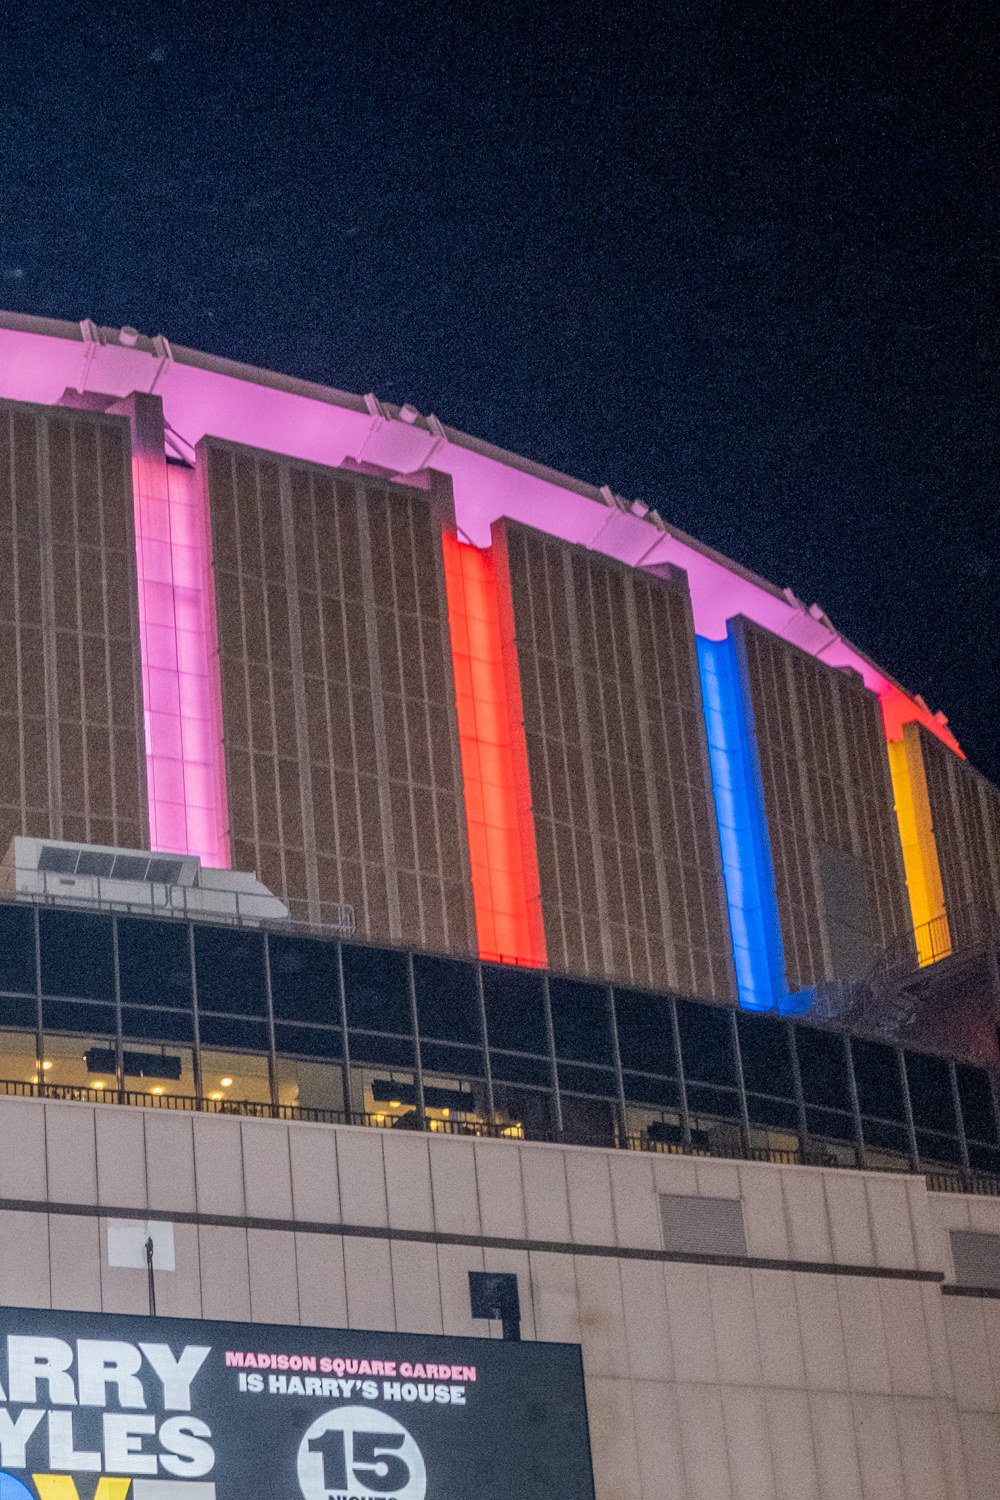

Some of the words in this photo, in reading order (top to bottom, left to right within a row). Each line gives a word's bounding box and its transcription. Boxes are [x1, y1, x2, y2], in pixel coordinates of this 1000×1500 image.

[225, 1351, 317, 1372] MADISON
[319, 1357, 397, 1378] SQUARE
[399, 1362, 477, 1381] GARDEN
[239, 1373, 264, 1393] IS
[269, 1375, 379, 1399] HARRY'S
[383, 1381, 466, 1405] HOUSE
[307, 1428, 411, 1492] 15
